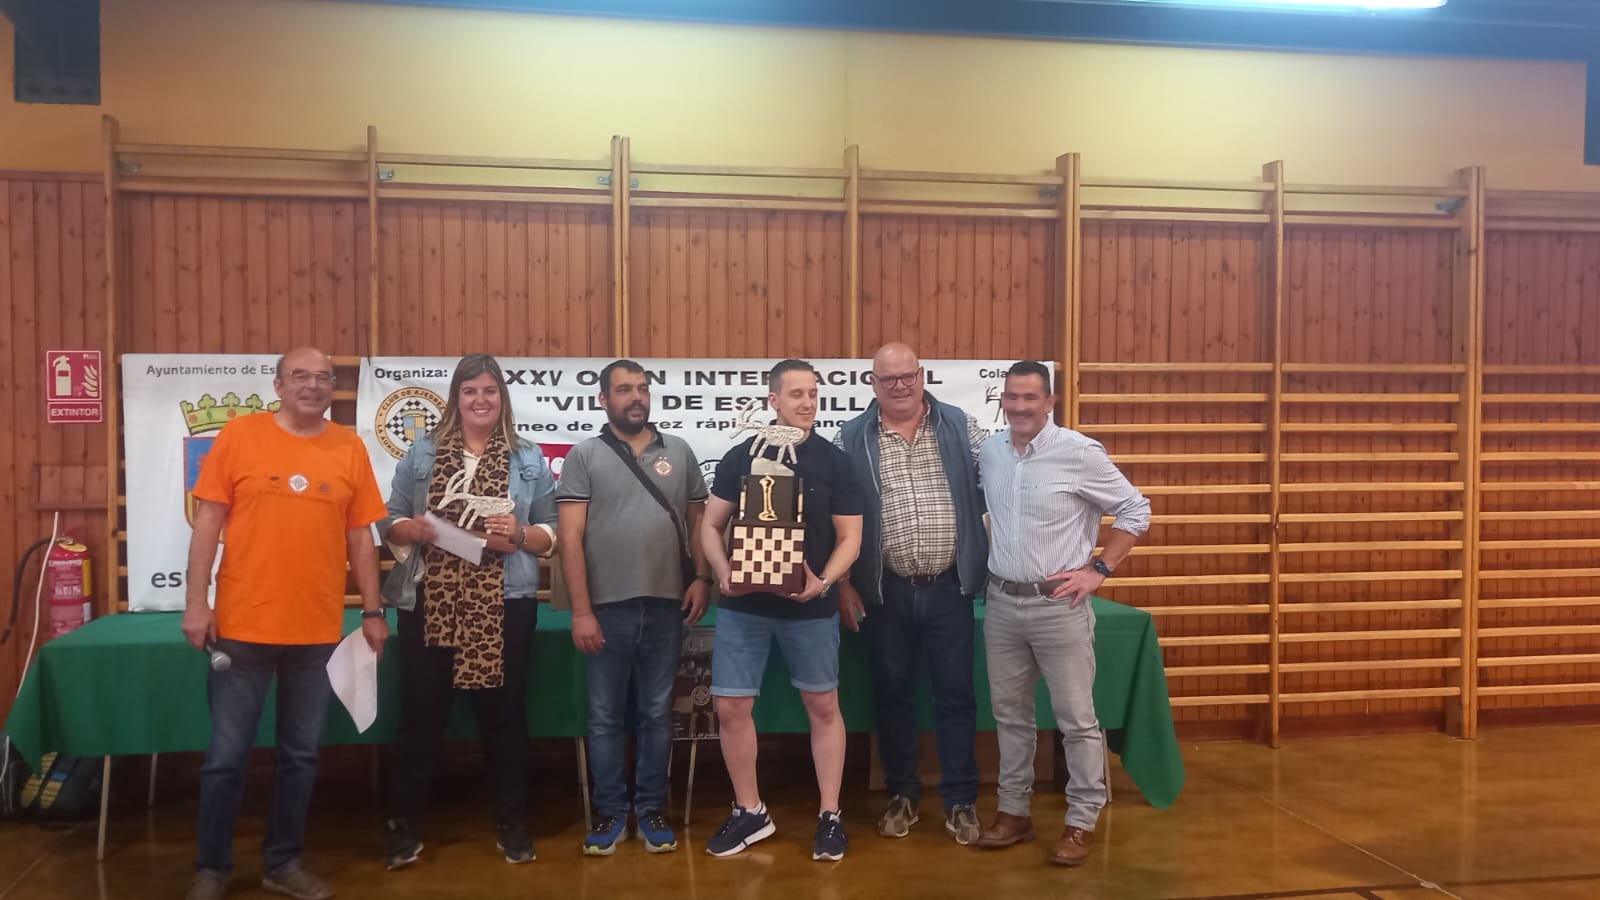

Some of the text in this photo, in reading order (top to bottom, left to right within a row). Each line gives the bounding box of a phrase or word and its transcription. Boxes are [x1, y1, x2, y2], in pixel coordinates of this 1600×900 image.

[146, 365, 277, 377] Ayuntamiento de Es
[375, 368, 448, 380] Organiza:
[576, 370, 666, 386] ON
[979, 368, 1008, 379] Cola
[383, 394, 399, 410] CLUB
[662, 395, 703, 410] DE
[51, 408, 98, 416] EXTINTOR
[513, 423, 558, 432] neo
[566, 421, 593, 432] de
[696, 418, 736, 431] rápi
[151, 571, 188, 588] es
